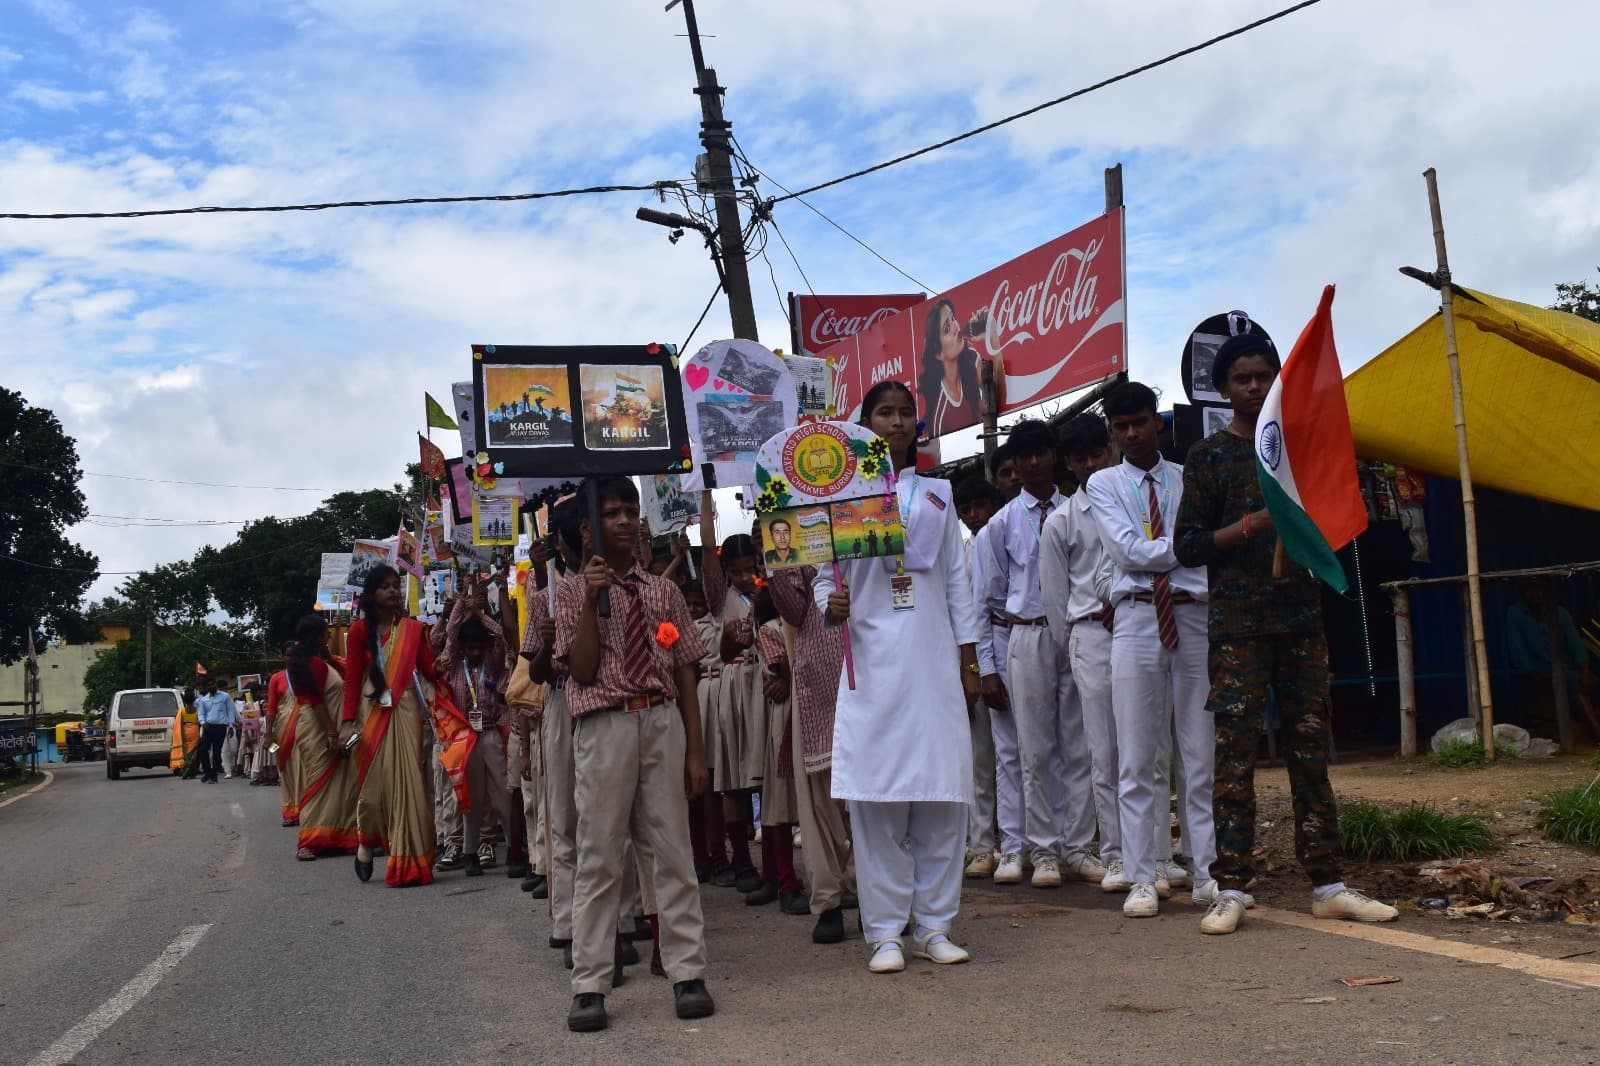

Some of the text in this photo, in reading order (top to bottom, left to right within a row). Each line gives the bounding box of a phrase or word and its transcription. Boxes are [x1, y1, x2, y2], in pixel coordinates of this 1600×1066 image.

[984, 236, 1104, 356] Coca-Cola
[871, 355, 902, 385] AMAN
[510, 422, 549, 430] KARGIL
[602, 426, 650, 437] KARGIL
[783, 440, 797, 472] OXFORD
[795, 426, 815, 441] HIGH
[817, 425, 848, 444] SCHOOL
[792, 469, 853, 495] CHAKME BURMU
